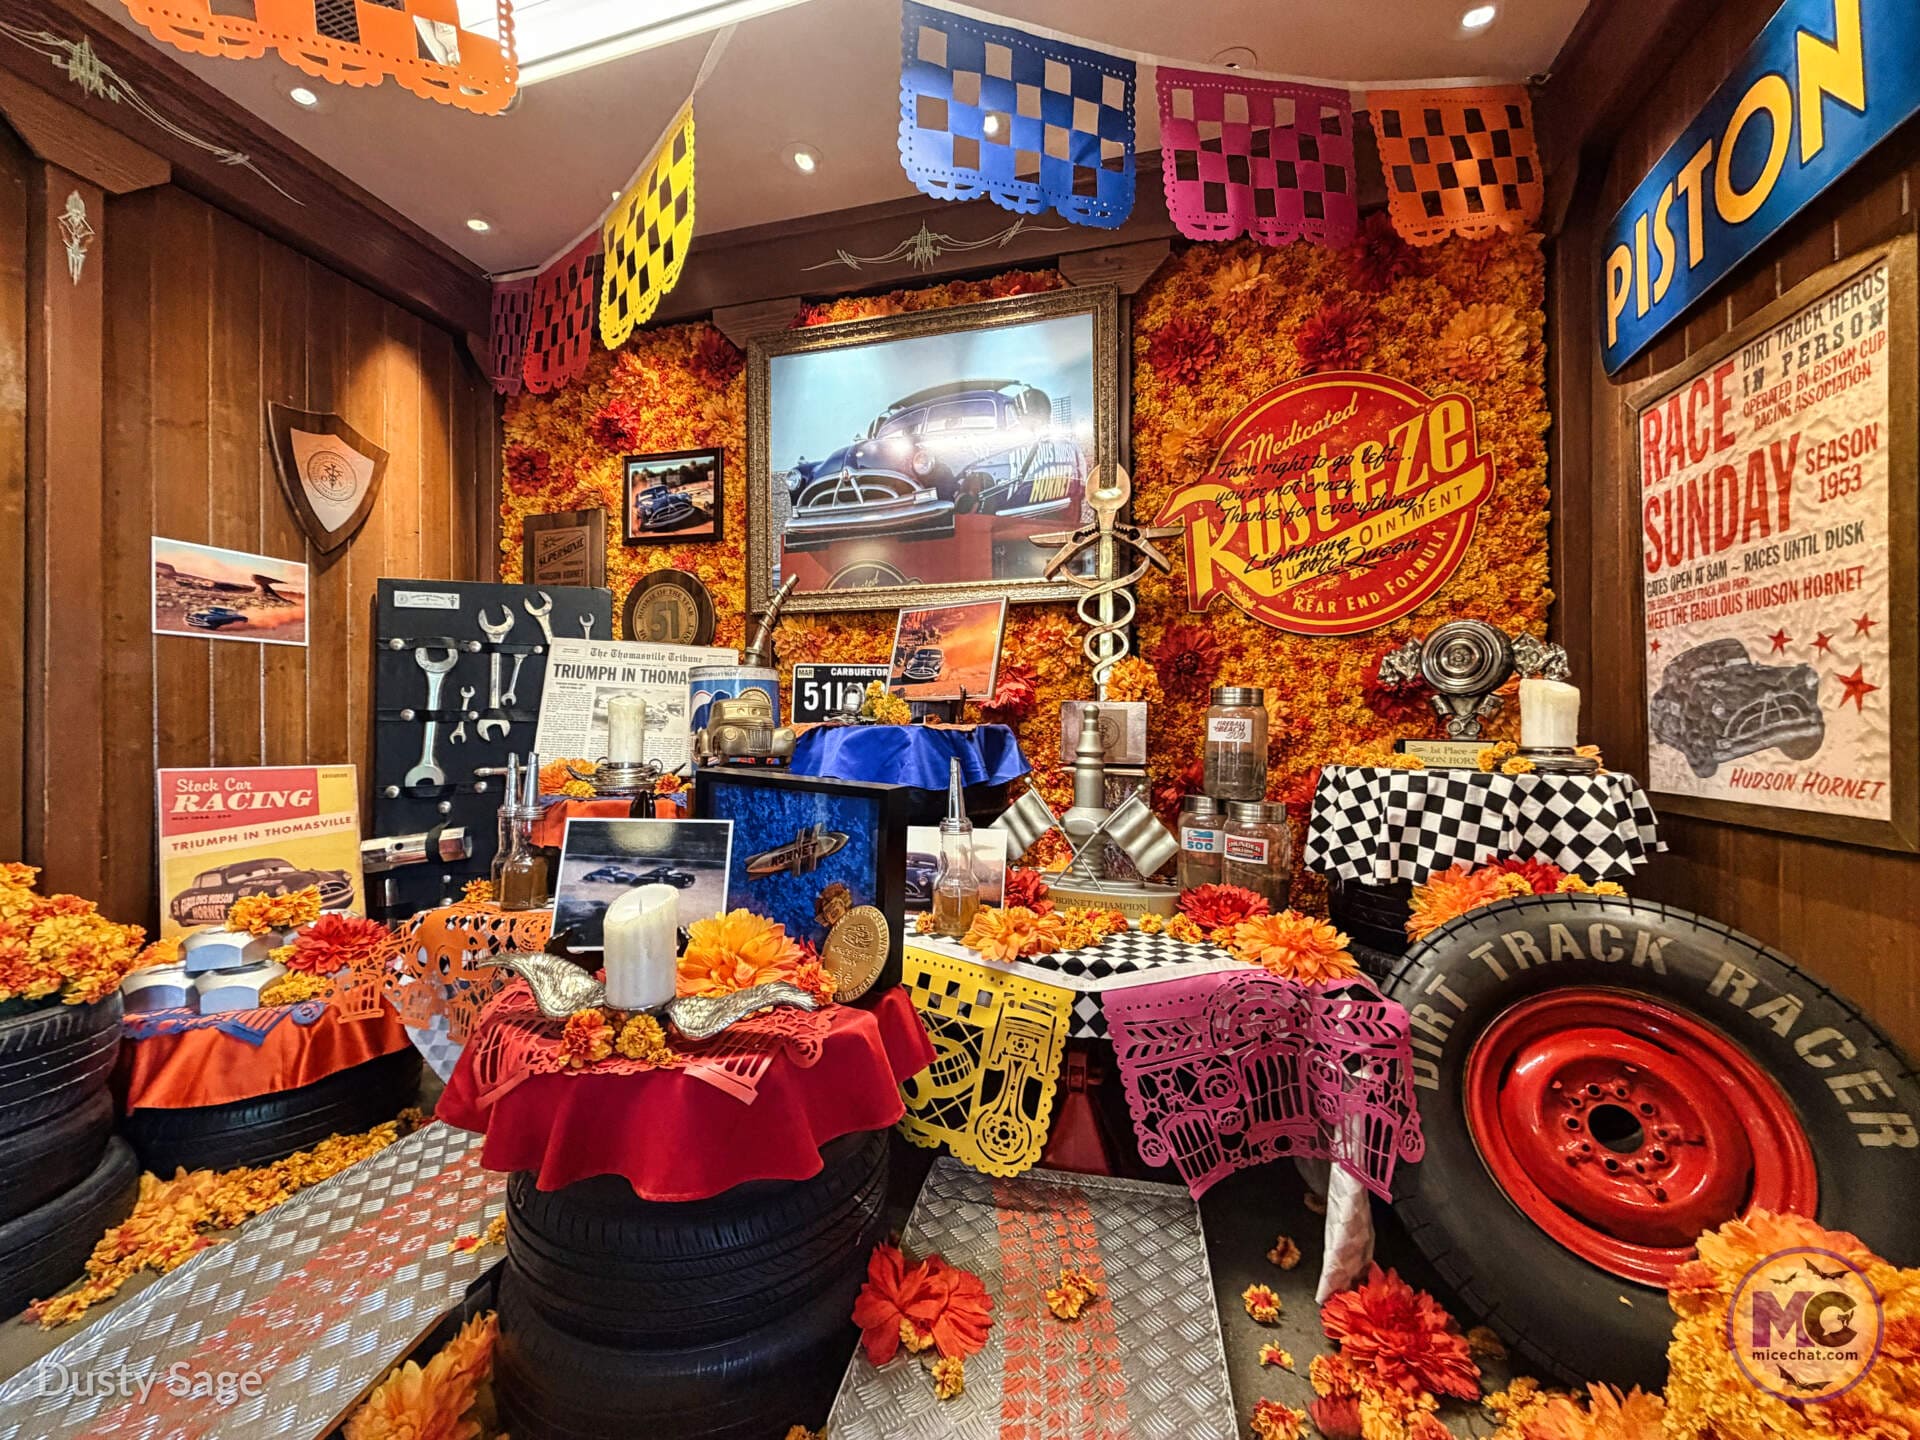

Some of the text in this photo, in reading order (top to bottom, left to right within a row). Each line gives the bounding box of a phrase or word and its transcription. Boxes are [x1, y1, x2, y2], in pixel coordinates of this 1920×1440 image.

[1607, 0, 1865, 349] PISTON
[1742, 266, 1886, 371] DIRT TRACK HEROS
[1743, 297, 1886, 398] IN PERSON
[1742, 330, 1886, 418] OPERATED BY PISTON CUP
[1754, 359, 1872, 432] RACING ASSOCIATION
[1238, 391, 1359, 465] Medicated
[1642, 359, 1735, 487] RACE
[1218, 460, 1258, 479] Turn
[1261, 452, 1310, 479] right
[1311, 455, 1328, 470] to
[1332, 456, 1355, 473] go
[1805, 422, 1879, 476] SEASON
[1215, 478, 1361, 508] you're not crazy.
[1643, 432, 1802, 573] SUNDAY
[1817, 462, 1862, 504] 1953
[1216, 488, 1432, 526] Thanks for everything!
[1359, 485, 1463, 546] OINTMENT
[1243, 537, 1351, 574] Lightning
[1294, 531, 1447, 613] REAR END FORMULA
[1647, 577, 1668, 598] GATES
[1670, 569, 1692, 592] OPEN
[1694, 566, 1705, 585] AT
[1707, 560, 1728, 582] 8AM
[1743, 546, 1780, 572] RACES
[1783, 537, 1820, 563] UNTIL
[1825, 521, 1865, 549] DUSK
[1647, 612, 1668, 631] MEET
[1671, 605, 1688, 626] THE
[1691, 593, 1743, 622] FABULOUS
[1746, 582, 1799, 611] HUDSON
[1803, 565, 1865, 601] HORNET
[651, 600, 680, 641] 51
[553, 663, 617, 681] TRIUMPH
[621, 667, 636, 682] IN
[590, 648, 608, 659] The
[611, 649, 666, 662] Thomasville
[668, 652, 703, 663] Tribune
[831, 667, 888, 677] CARBURETOR
[169, 789, 313, 813] RACING
[176, 777, 253, 793] Stock Car
[1730, 766, 1886, 801] HUDSON HORNET
[171, 816, 352, 851] TRIUMPH IN THOMASVILLE
[1187, 841, 1213, 850] 500
[769, 842, 818, 867] HORNET
[1055, 896, 1147, 911] HORNET CHAMPION
[1410, 922, 1920, 1151] DIRT TRACK RACER
